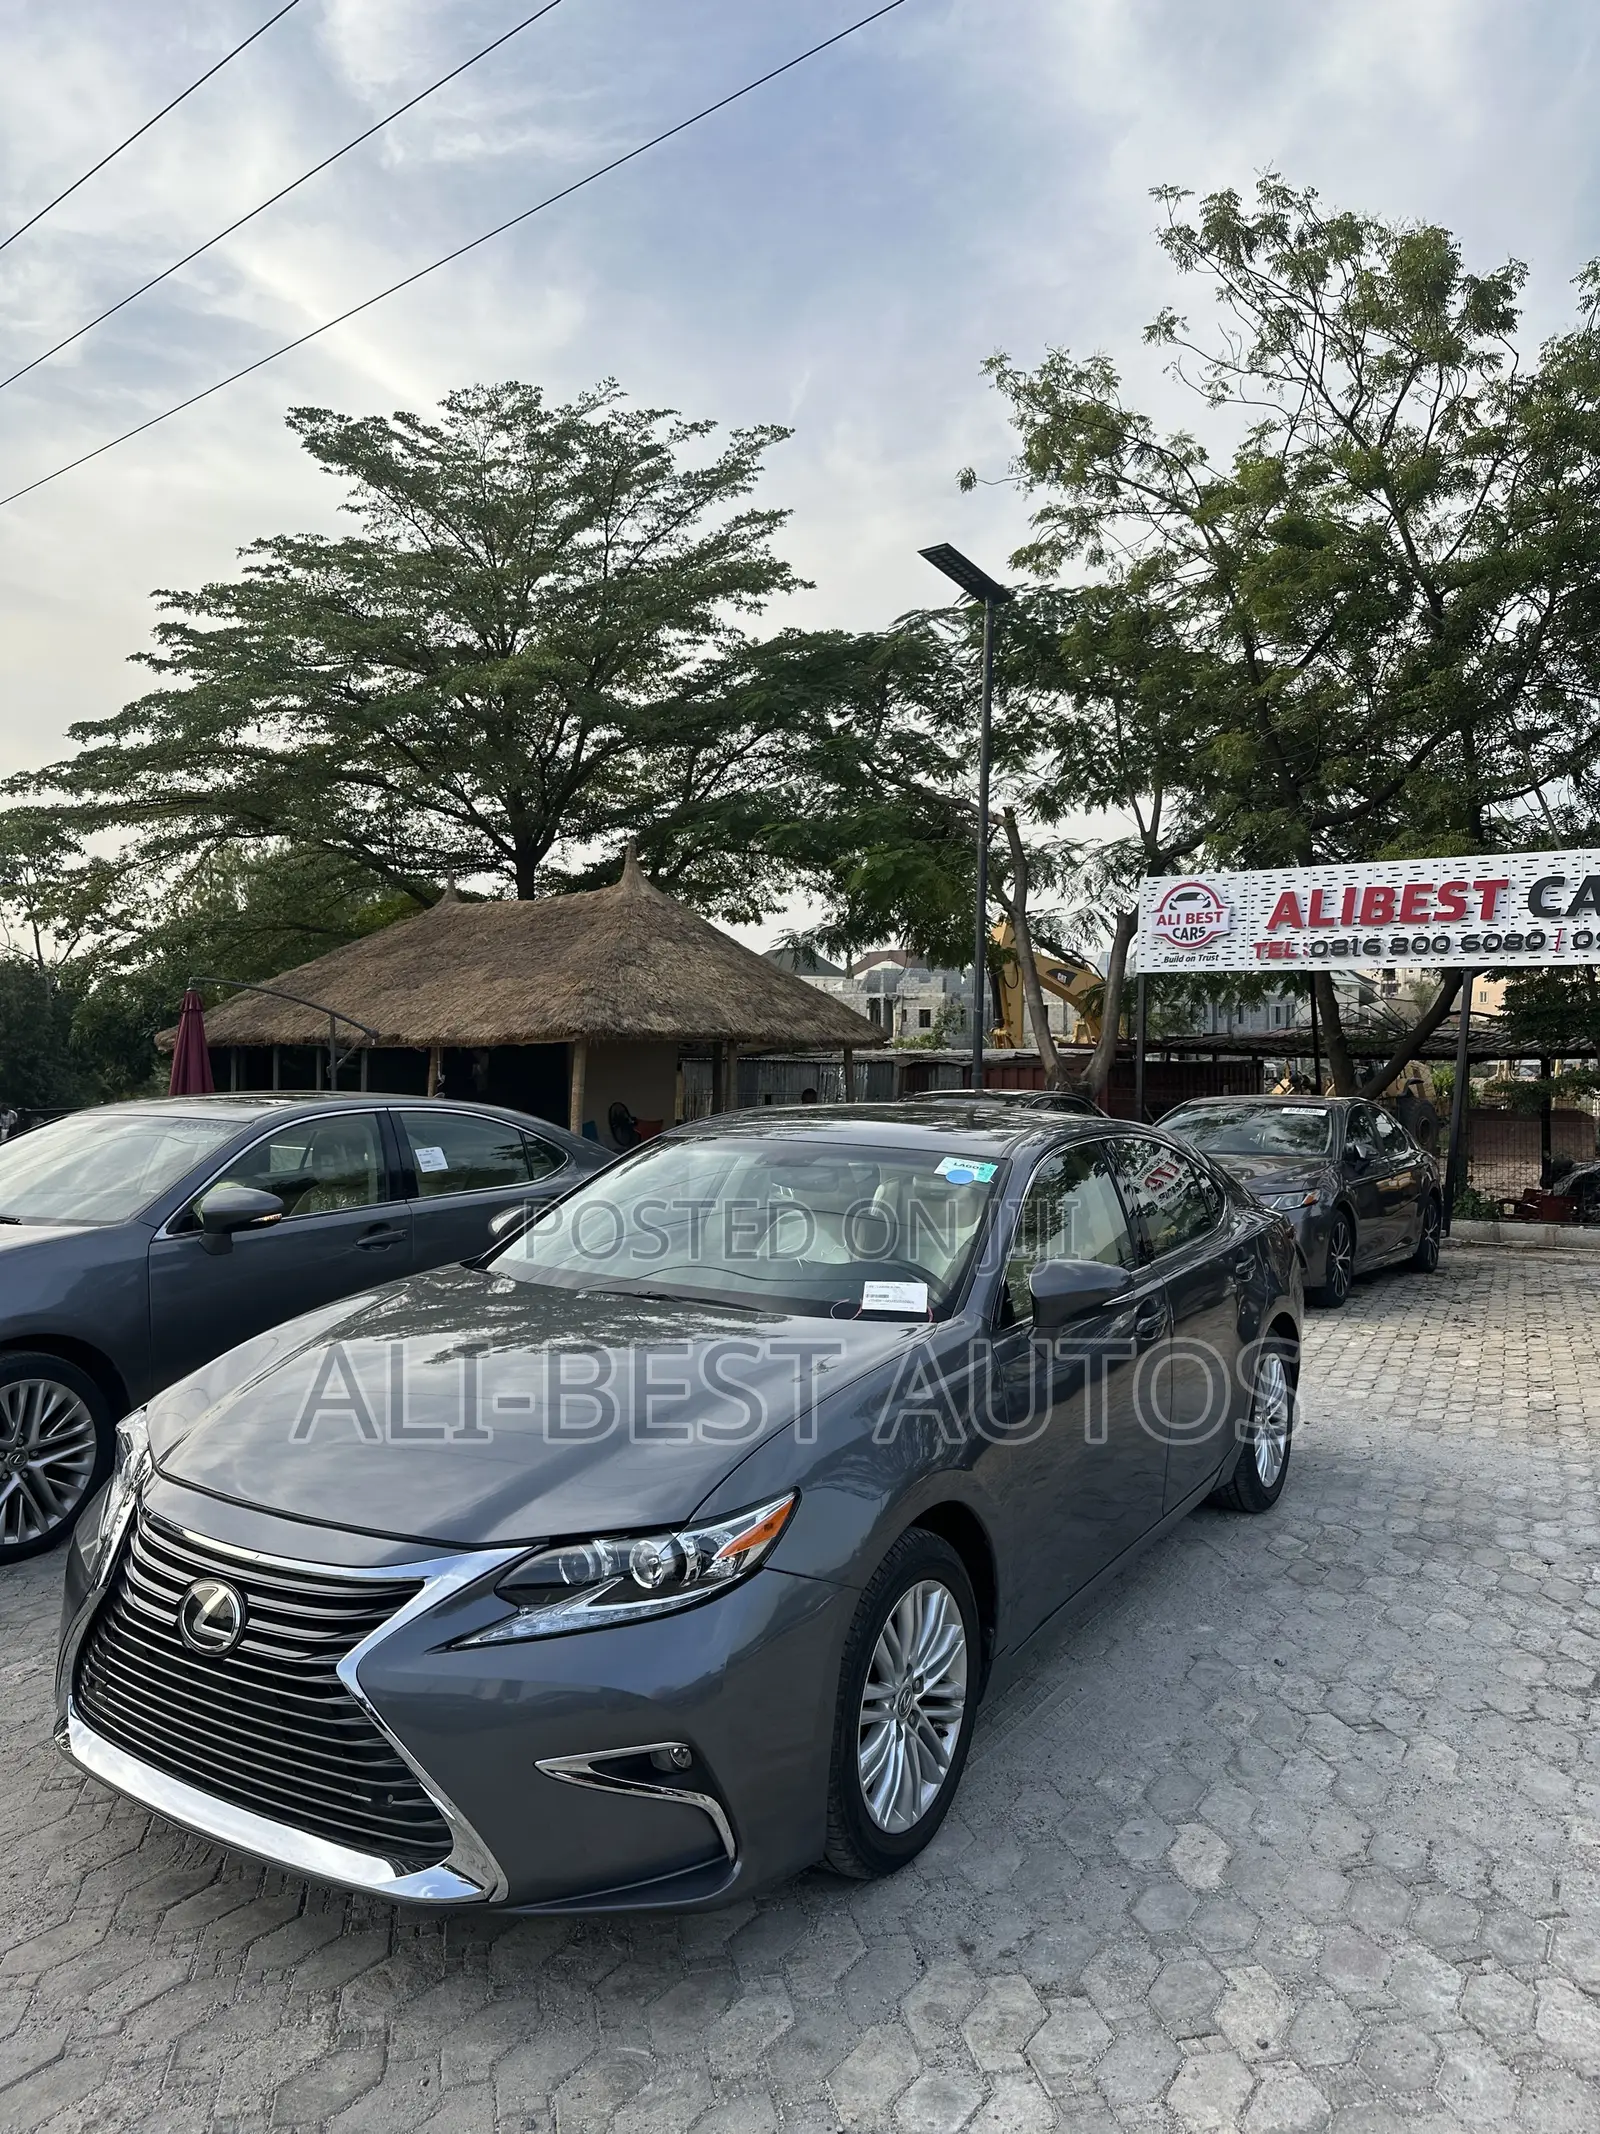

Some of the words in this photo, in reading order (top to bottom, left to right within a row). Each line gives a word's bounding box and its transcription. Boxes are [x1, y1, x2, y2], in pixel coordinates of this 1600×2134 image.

[1266, 879, 1510, 931] ALIBEST
[1156, 913, 1181, 926] ALI
[1185, 911, 1224, 925] BEST
[1172, 926, 1206, 941] CARS
[1310, 937, 1382, 958] 0816
[1389, 935, 1451, 956] 800
[1461, 931, 1546, 953] 6080
[1572, 930, 1600, 950] 0
[1163, 954, 1184, 964] Build
[1185, 955, 1196, 963] on
[1198, 954, 1220, 962] Trust
